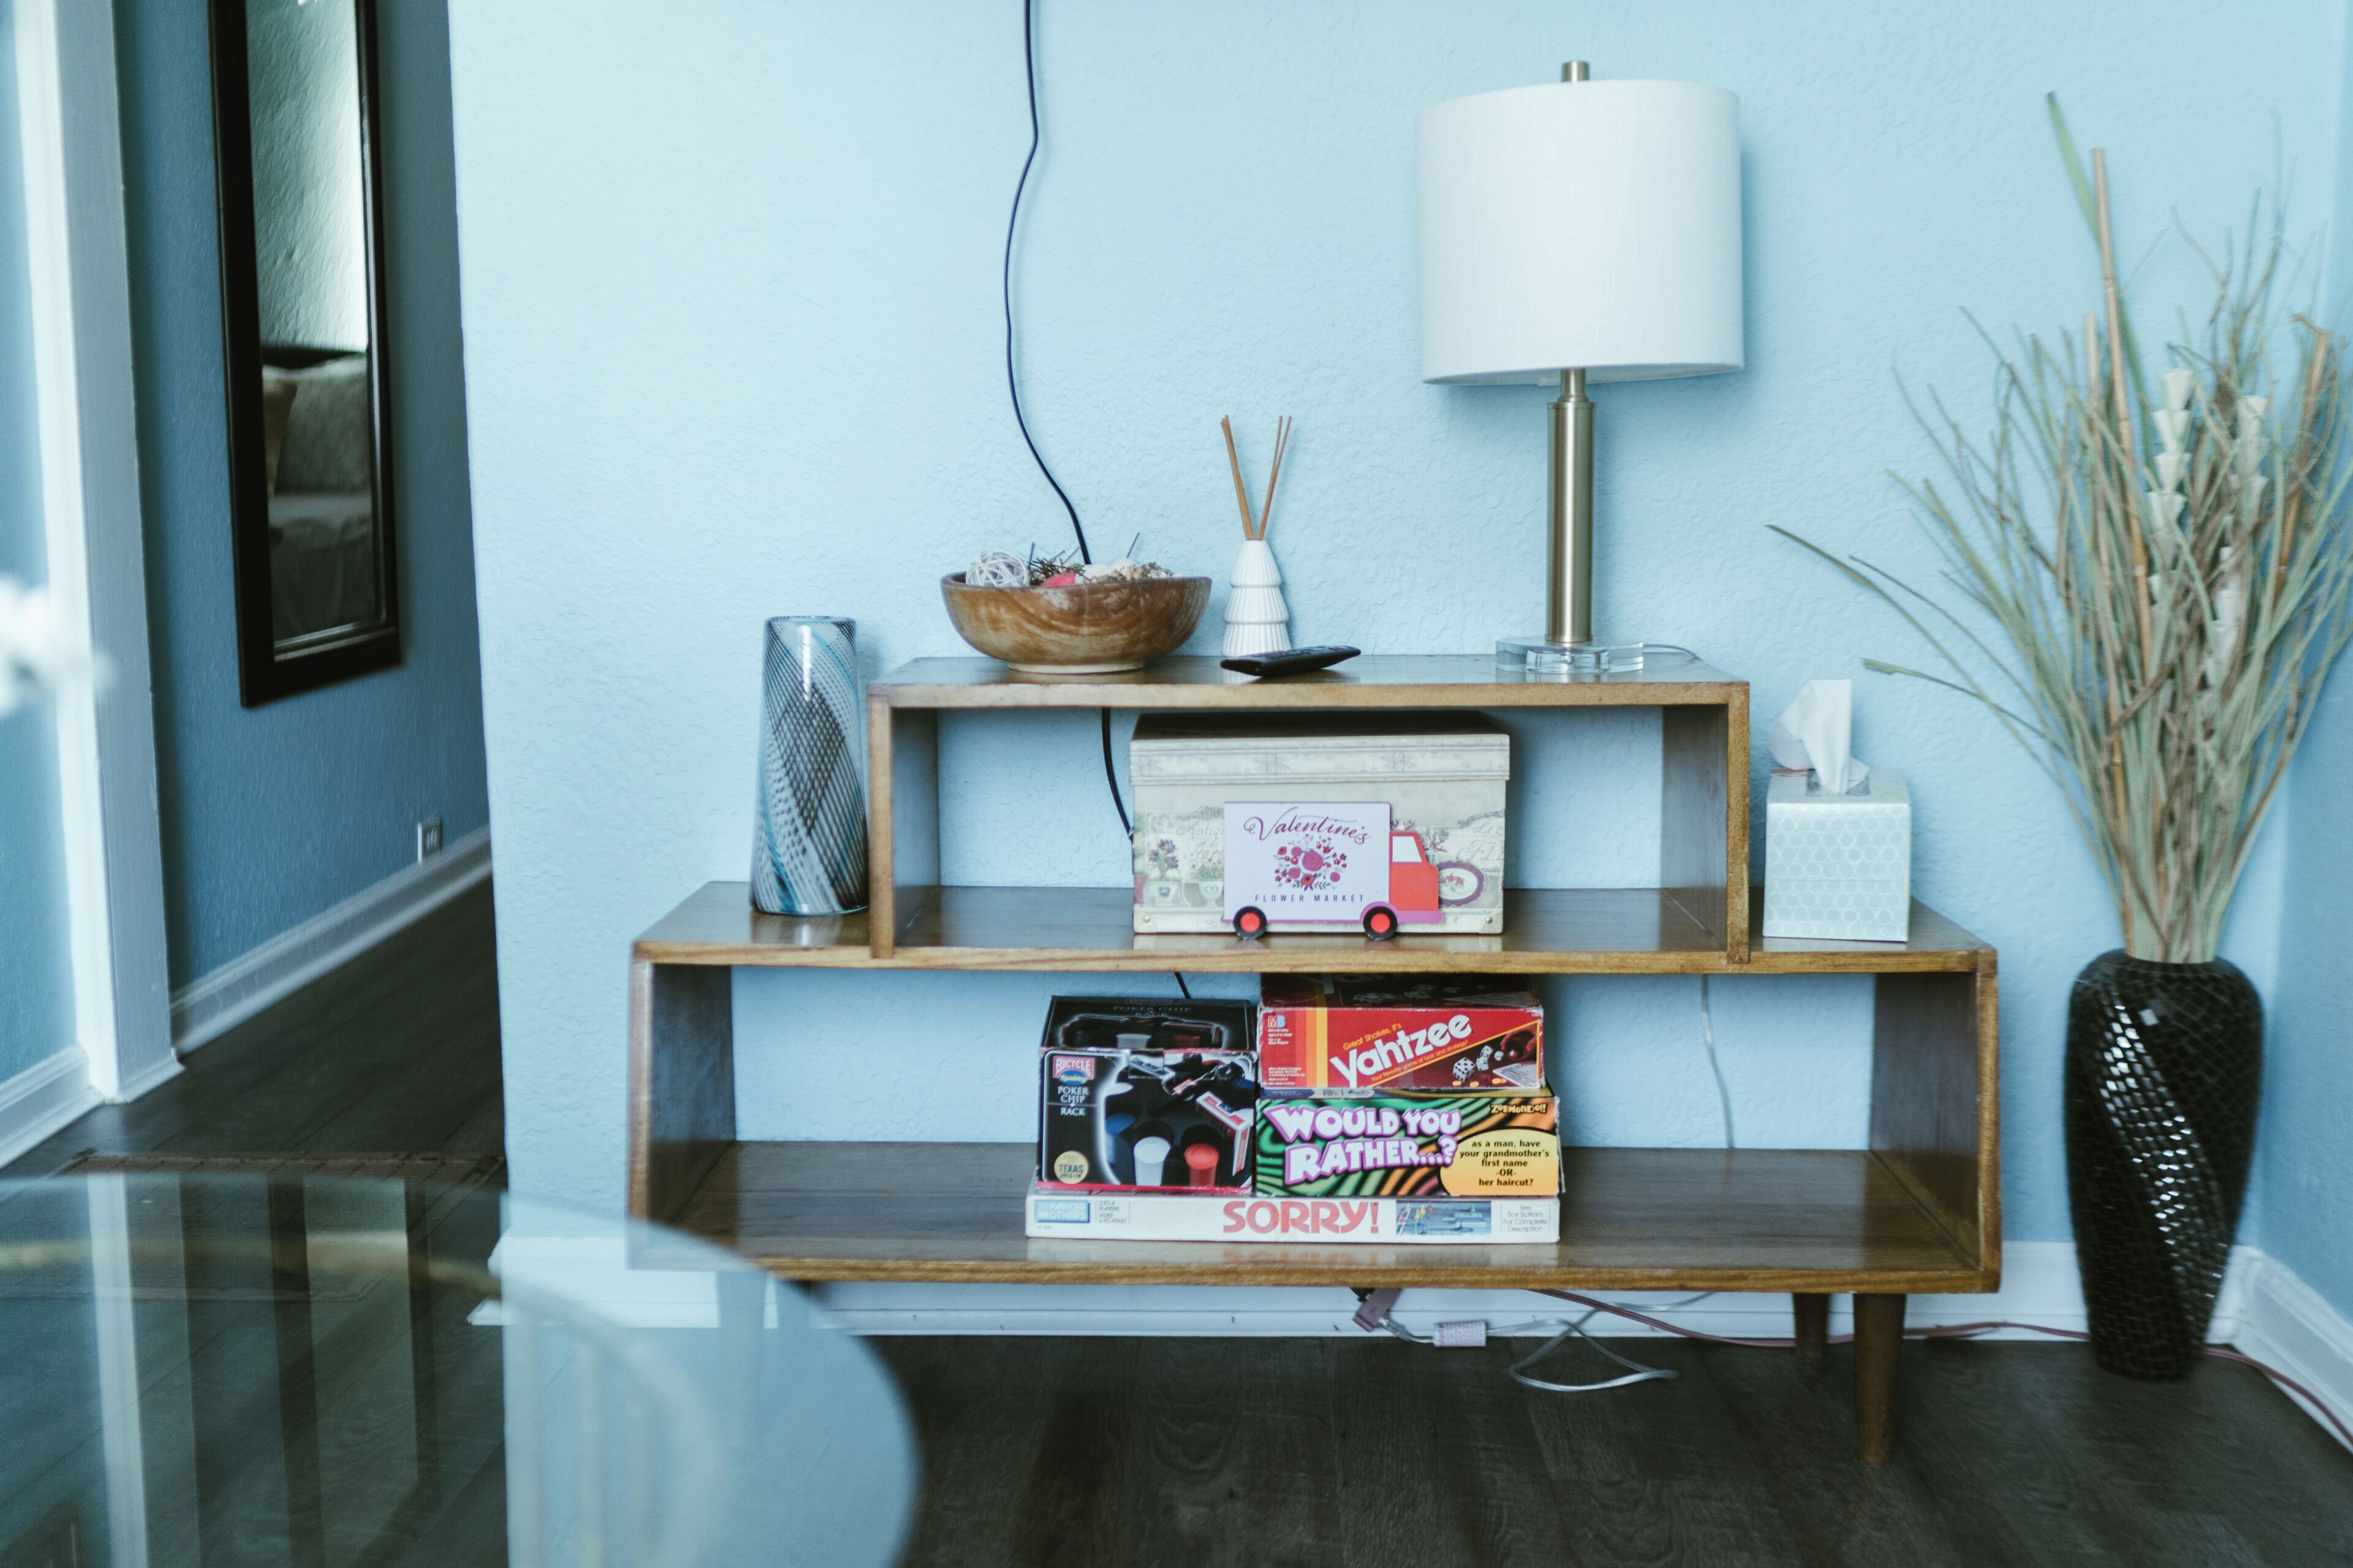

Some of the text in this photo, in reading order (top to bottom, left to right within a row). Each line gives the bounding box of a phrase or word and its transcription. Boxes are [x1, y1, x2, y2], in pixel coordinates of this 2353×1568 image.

[1243, 806, 1371, 844] Valentine's
[1268, 1015, 1286, 1028] MB
[1343, 1037, 1364, 1050] Great
[1365, 1028, 1392, 1043] Shakes,
[1330, 1015, 1472, 1088] Yahtzee
[1055, 1058, 1091, 1077] BICYCLE
[1382, 1066, 1402, 1078] favorite
[1403, 1060, 1417, 1072] game
[1423, 1053, 1434, 1062] luck
[1436, 1048, 1446, 1057] and
[1058, 1086, 1089, 1096] POKER
[1060, 1094, 1086, 1103] CHIP
[1060, 1107, 1086, 1116] RACK
[1265, 1105, 1401, 1142] WOULD
[1403, 1108, 1461, 1136] YOU
[1285, 1135, 1457, 1184] RATHER...?
[1460, 1149, 1550, 1159] your grandmother's
[1059, 1164, 1083, 1173] TEXAS
[1223, 1200, 1379, 1234] SORRY!
